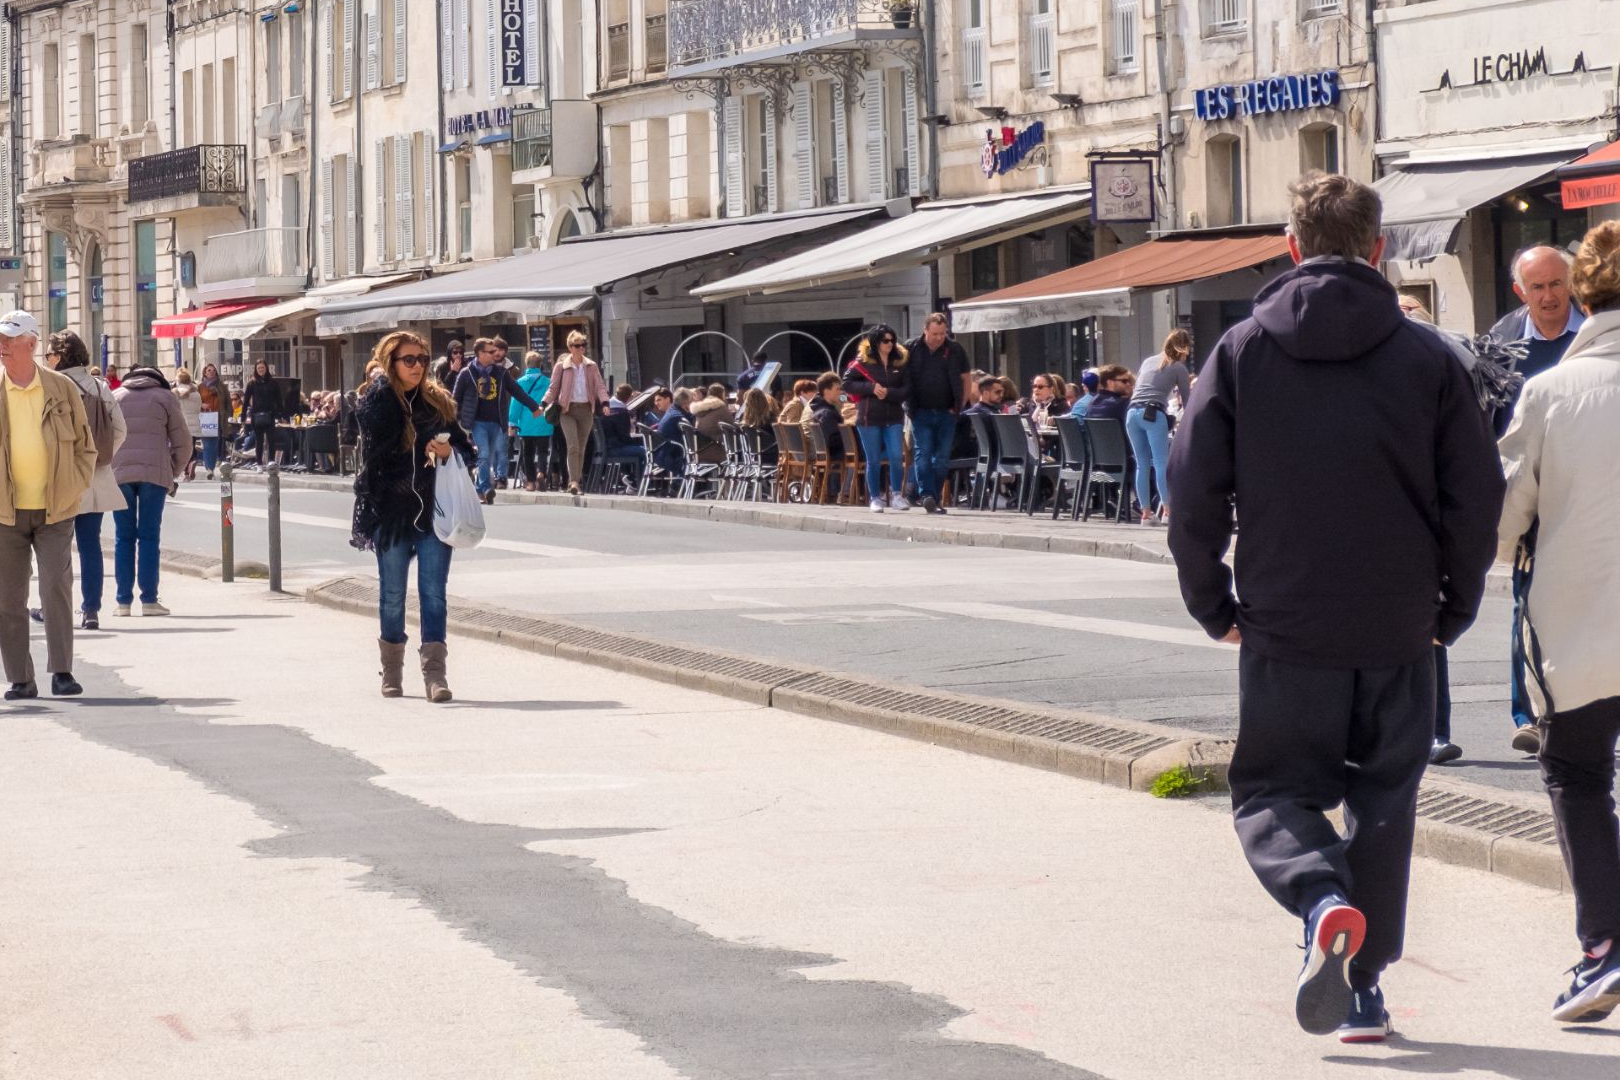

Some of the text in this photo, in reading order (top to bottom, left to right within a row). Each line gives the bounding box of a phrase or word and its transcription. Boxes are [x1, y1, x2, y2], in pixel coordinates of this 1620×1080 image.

[1474, 55, 1492, 85] LE
[1193, 71, 1332, 121] LES REGATES
